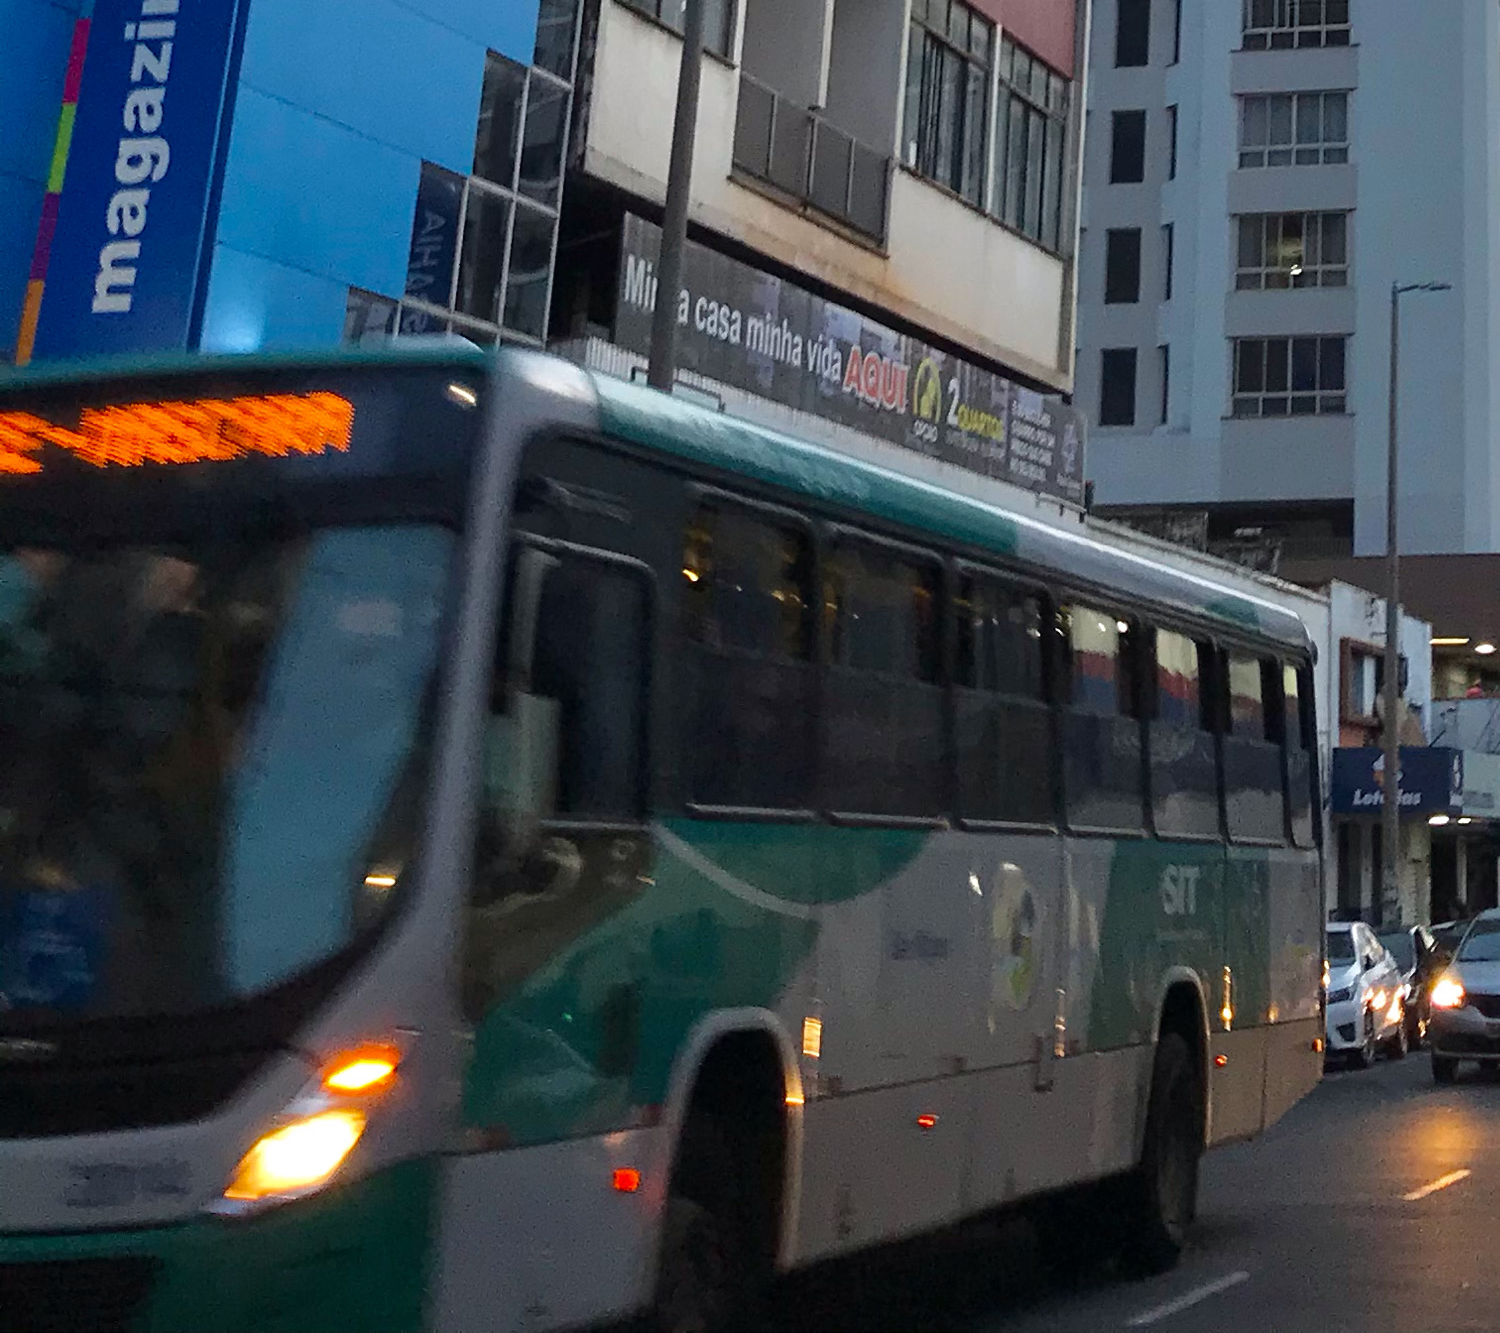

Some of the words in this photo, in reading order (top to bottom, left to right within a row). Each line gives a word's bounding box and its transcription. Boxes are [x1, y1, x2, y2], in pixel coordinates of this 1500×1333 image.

[624, 253, 690, 327] Mia
[695, 295, 742, 346] casa
[746, 312, 803, 367] minha
[807, 334, 842, 381] vida
[842, 345, 909, 414] AQUI
[947, 377, 960, 426] 2
[1353, 788, 1423, 806] Lotias
